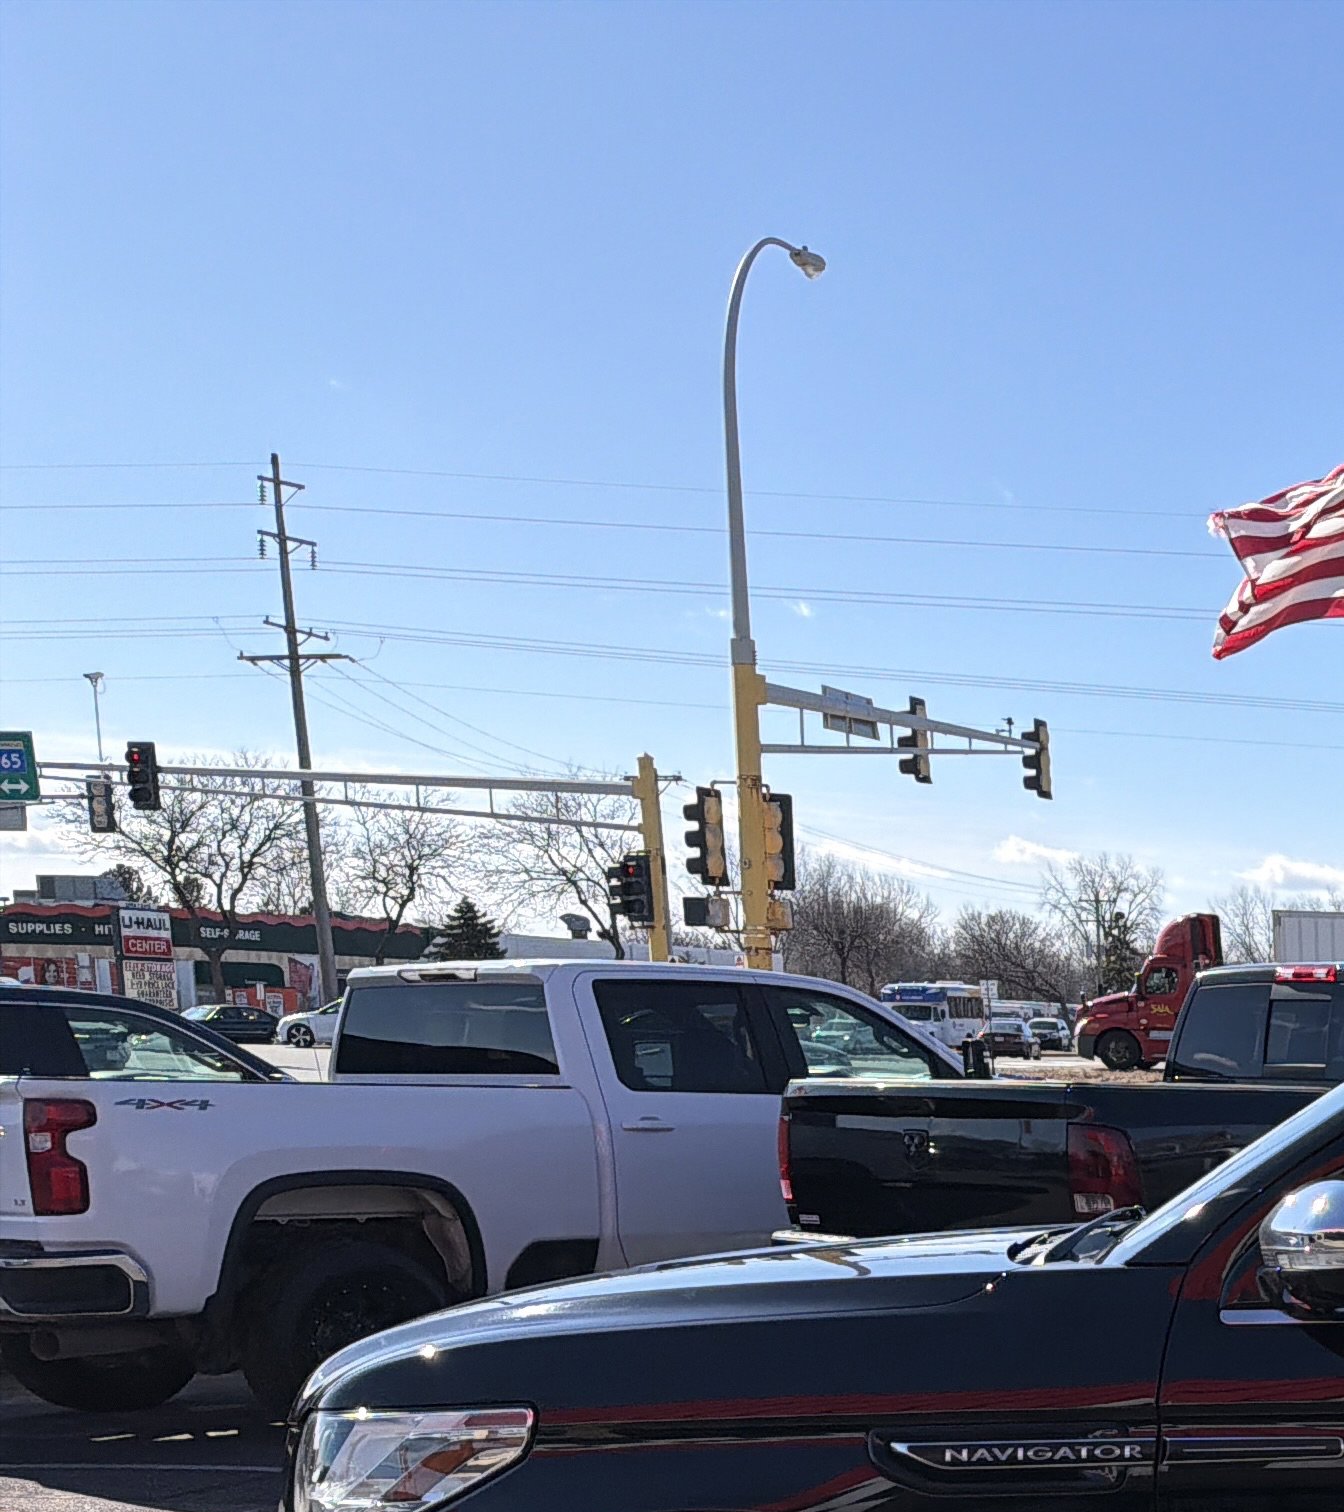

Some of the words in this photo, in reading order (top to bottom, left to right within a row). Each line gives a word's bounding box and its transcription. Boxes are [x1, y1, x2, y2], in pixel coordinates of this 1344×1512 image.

[1, 753, 22, 769] 65
[8, 922, 73, 935] SUPPLIES
[121, 916, 170, 931] U-HAUL
[199, 926, 261, 941] SELF-SRAGE
[128, 939, 168, 953] CENTER
[944, 1443, 1143, 1464] NAVIGATOR
